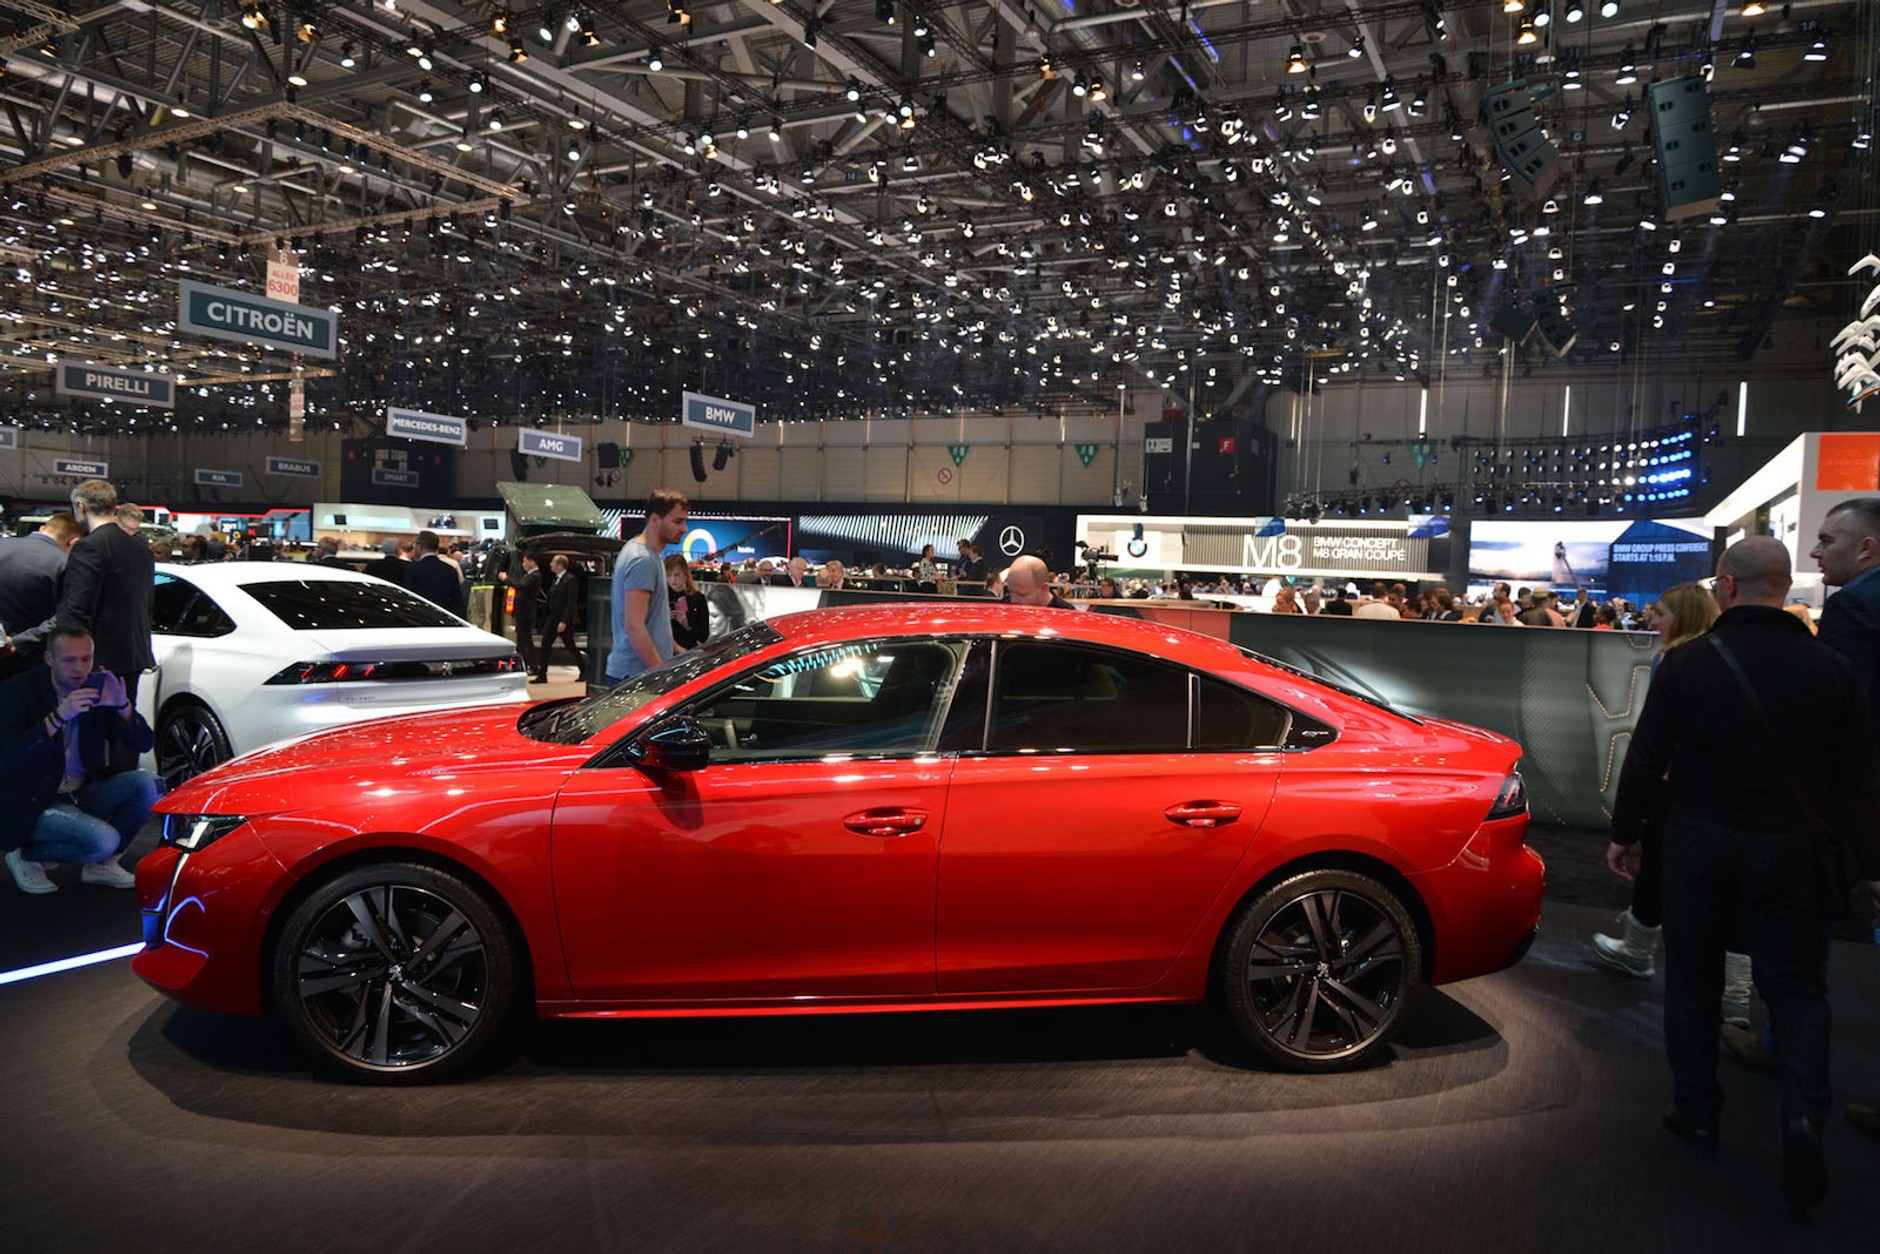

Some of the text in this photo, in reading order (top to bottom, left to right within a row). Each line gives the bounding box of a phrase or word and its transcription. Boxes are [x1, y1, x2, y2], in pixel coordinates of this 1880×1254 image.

[268, 279, 298, 297] 6300
[207, 301, 313, 340] CITROËN
[86, 373, 149, 394] PIRELLI
[704, 406, 736, 424] BMW
[392, 418, 462, 435] MERCEDES-BENZ
[538, 438, 564, 452] AMG
[65, 464, 97, 474] ARDEN
[1313, 536, 1398, 549] BMW CONCEPT
[1242, 534, 1302, 569] M8
[1312, 548, 1330, 559] M8
[1331, 548, 1363, 560] GRAN
[1613, 553, 1638, 562] STARTS
